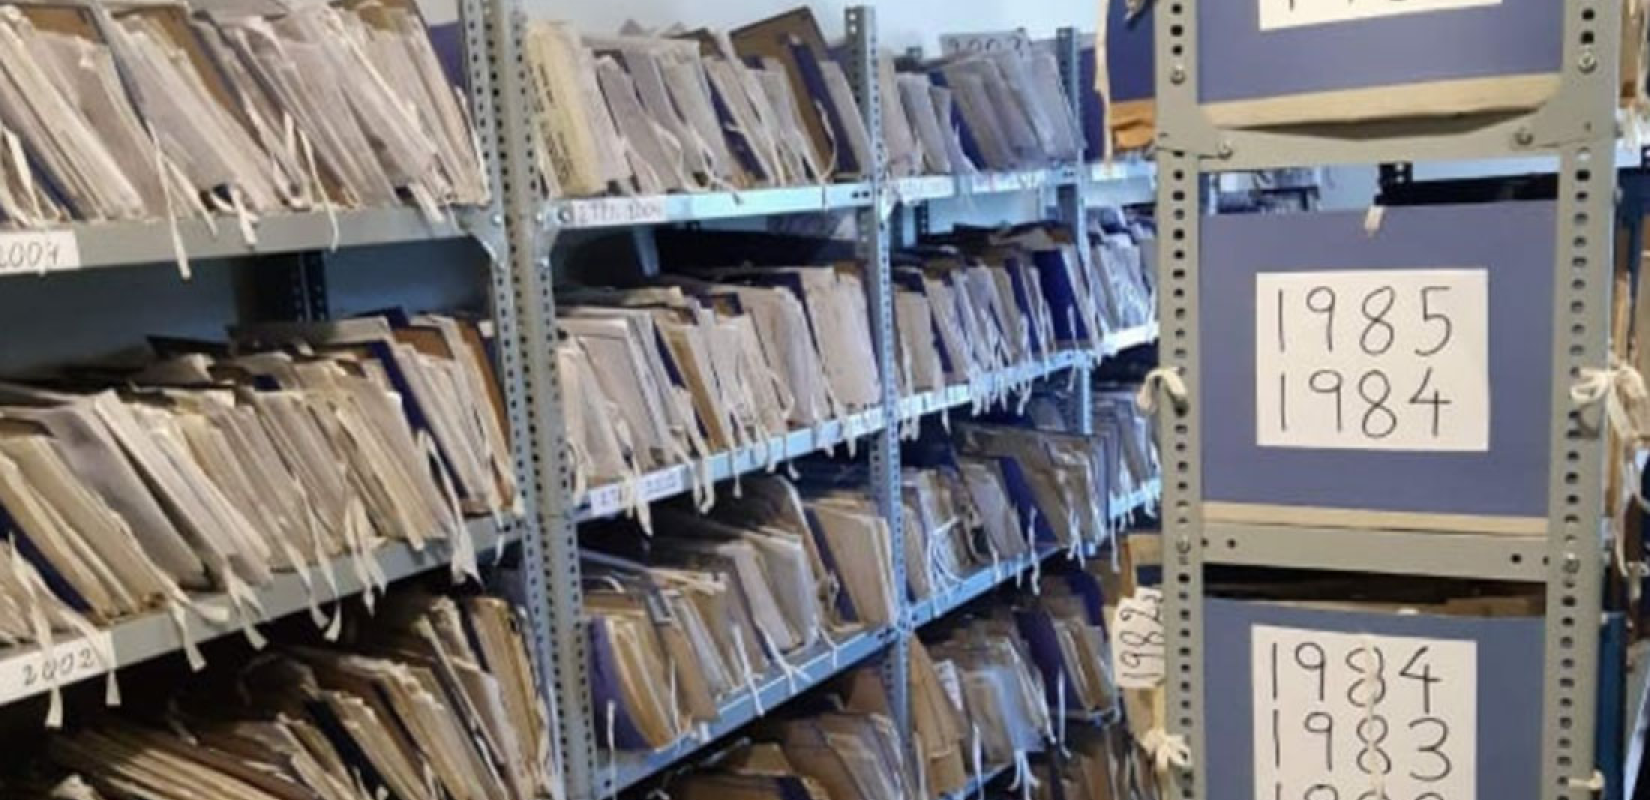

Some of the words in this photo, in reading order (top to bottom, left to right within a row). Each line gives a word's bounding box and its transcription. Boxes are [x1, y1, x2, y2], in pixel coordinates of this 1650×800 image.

[1278, 286, 1452, 356] 1985
[1279, 367, 1452, 439] 1984
[22, 647, 95, 686] 2002
[1272, 642, 1443, 714] 1984
[1273, 708, 1452, 781] 1983
